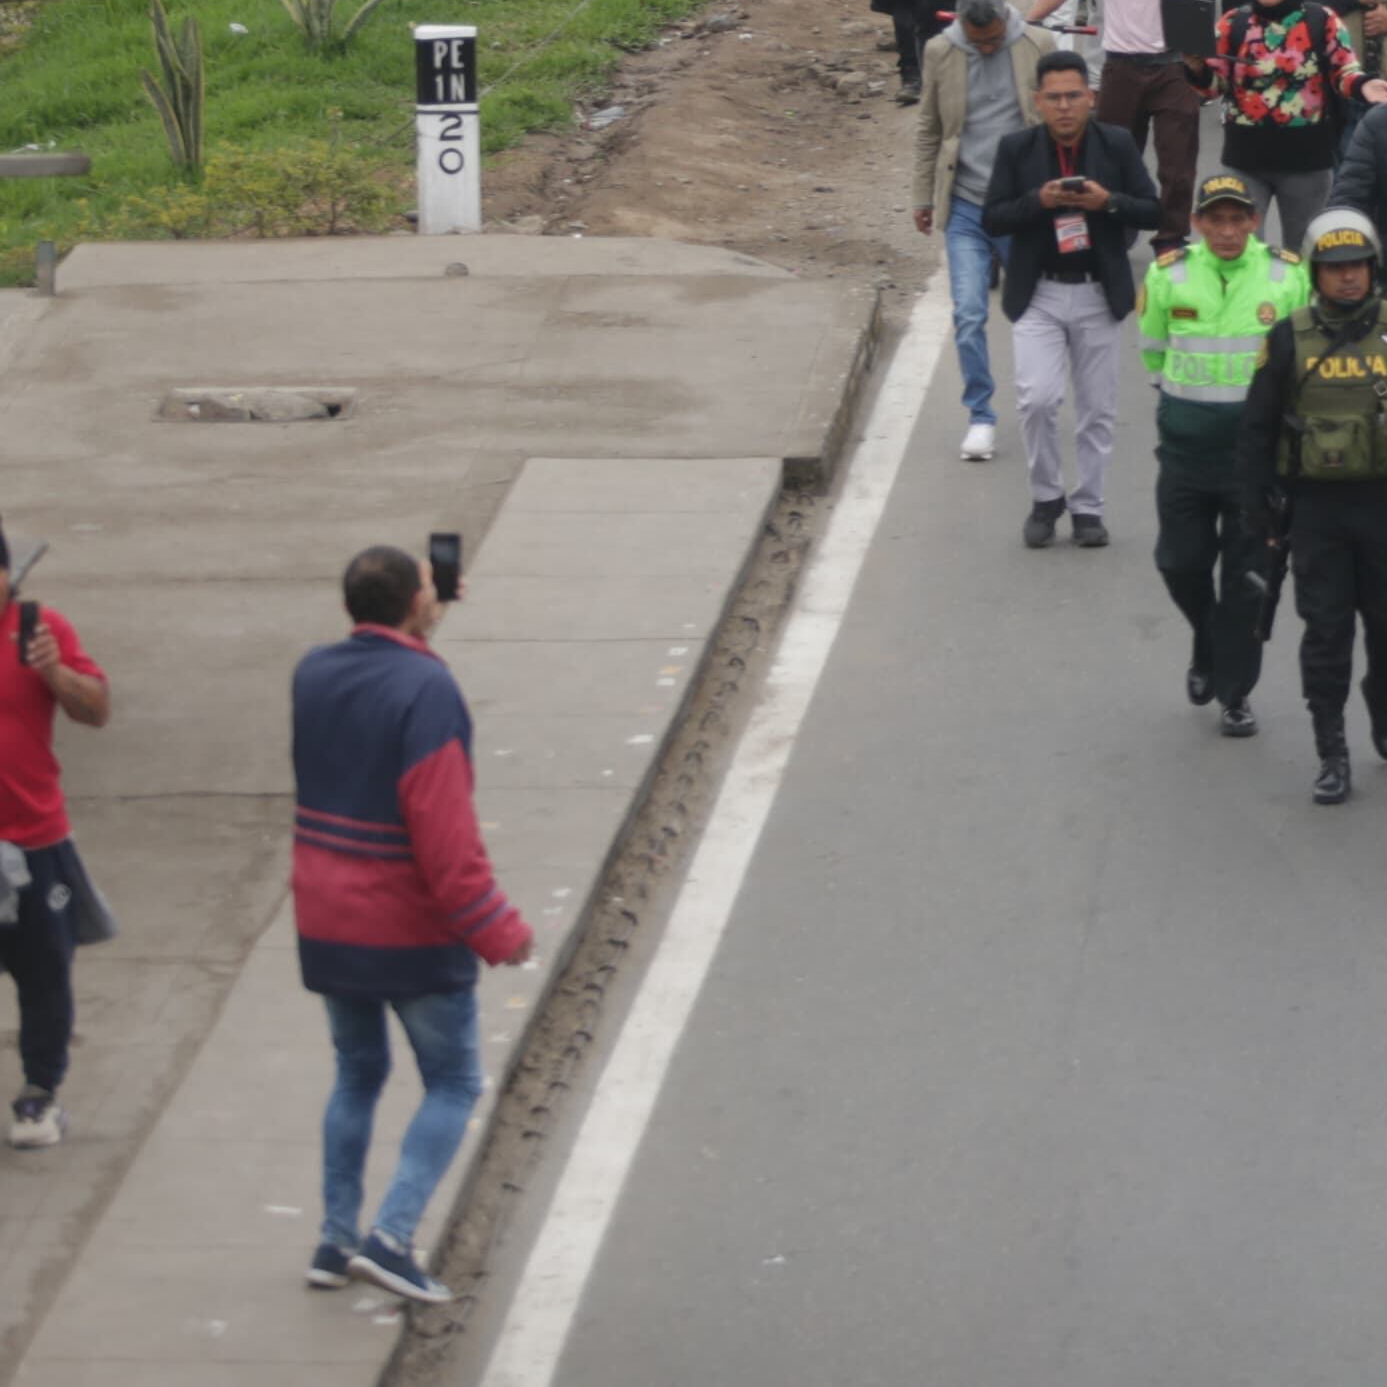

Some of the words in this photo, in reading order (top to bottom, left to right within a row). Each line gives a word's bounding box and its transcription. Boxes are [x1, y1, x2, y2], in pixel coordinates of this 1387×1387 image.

[432, 39, 465, 69] PE
[434, 73, 466, 102] 1N
[1318, 229, 1364, 251] POLICIA
